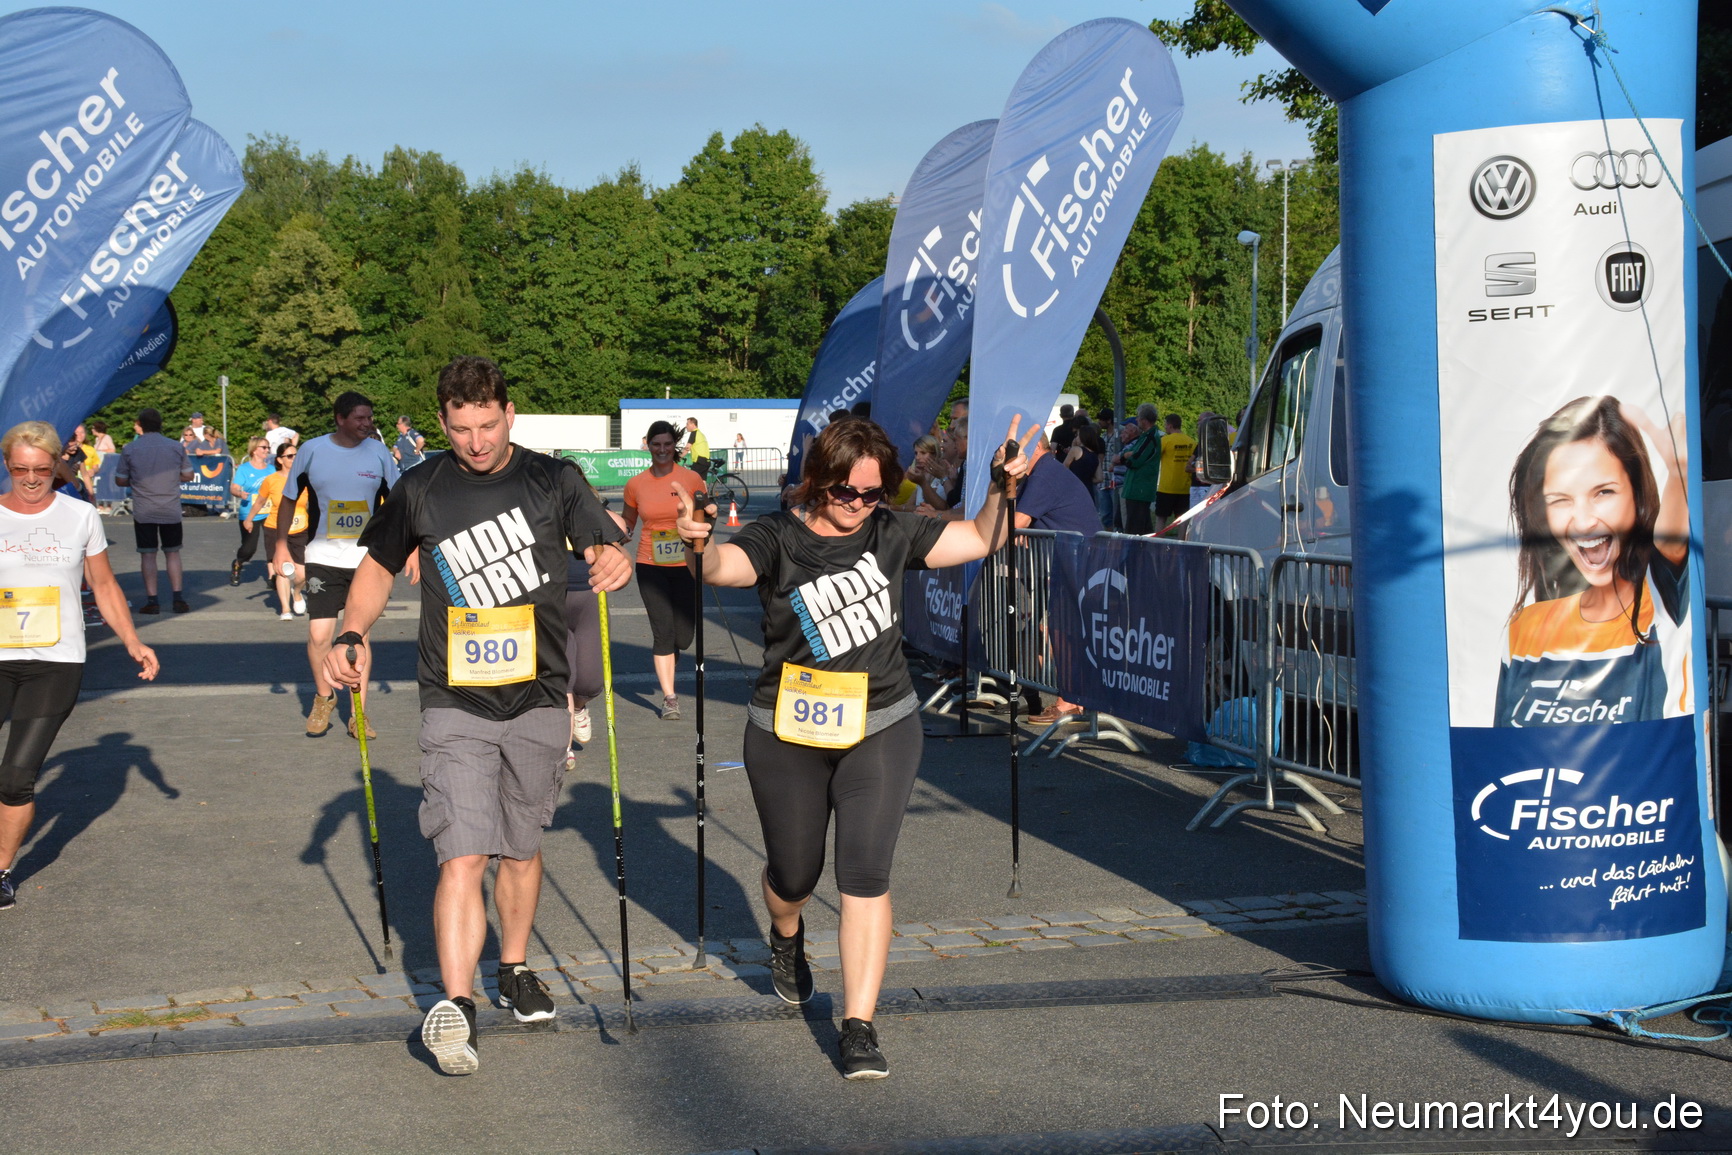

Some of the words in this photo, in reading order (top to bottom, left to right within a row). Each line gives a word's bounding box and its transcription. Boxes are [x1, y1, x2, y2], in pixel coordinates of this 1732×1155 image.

[1030, 67, 1140, 281] Fischer
[15, 112, 144, 281] AUTOMOBILE
[1070, 107, 1152, 278] AUTOMOBILE
[1573, 202, 1617, 216] Audi
[60, 151, 189, 321] Fischer
[107, 184, 206, 319] AUTOMOBILE
[1611, 262, 1643, 293] FIAT
[1468, 304, 1555, 323] SEAT
[135, 333, 168, 360] Medien
[806, 360, 876, 435] Frischm
[577, 457, 599, 474] OK
[607, 457, 653, 468] GESUNDH
[200, 484, 224, 492] Medien
[336, 515, 363, 528] 409
[0, 540, 59, 553] ktives
[24, 554, 71, 563] Neumarkt
[438, 506, 536, 580] MDN
[431, 545, 470, 608] TECHNOLO
[458, 547, 551, 609] DRV.
[799, 551, 890, 623] MDN
[16, 611, 31, 630] 7
[789, 587, 831, 663] TECHNOLOGY
[817, 587, 897, 659] DRV.
[465, 638, 518, 664] 980
[1091, 612, 1175, 671] Fischer
[1102, 668, 1170, 701] AUTOMOBILE
[794, 698, 844, 727] 981
[1525, 696, 1632, 725] Fischer
[798, 728, 814, 736] Nicole
[1510, 795, 1674, 830] Fischer
[1527, 829, 1666, 850] AUTOMOBILE
[1561, 869, 1596, 889] und
[1602, 863, 1635, 882] das
[1609, 886, 1656, 910] fährt
[1660, 872, 1692, 893] mit!
